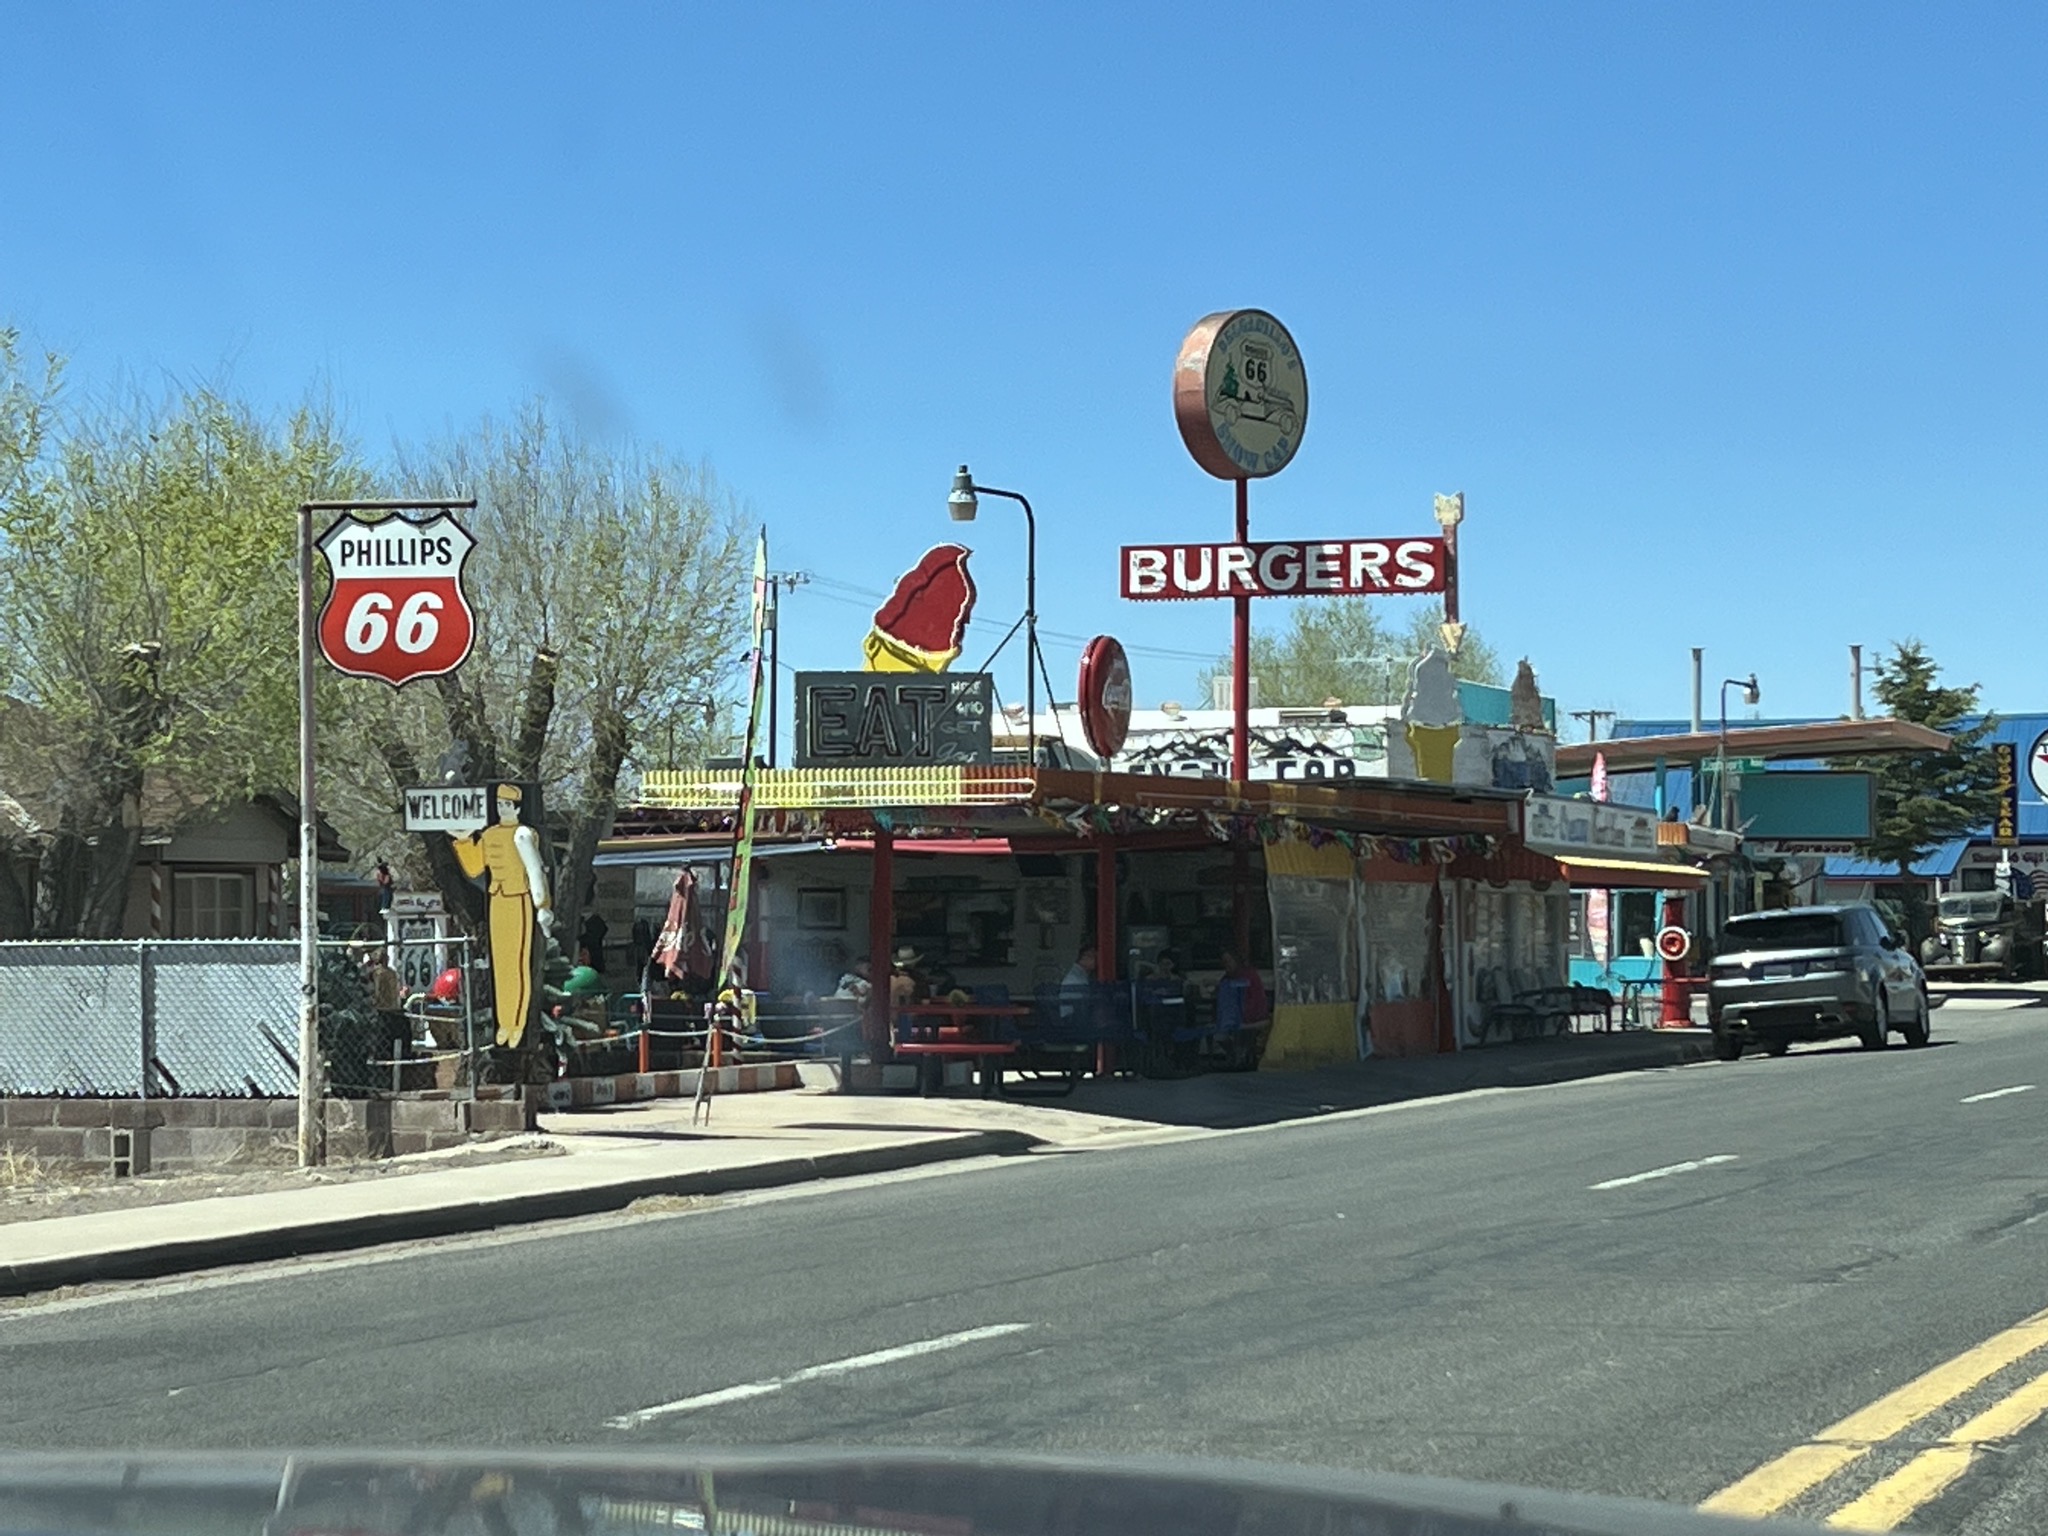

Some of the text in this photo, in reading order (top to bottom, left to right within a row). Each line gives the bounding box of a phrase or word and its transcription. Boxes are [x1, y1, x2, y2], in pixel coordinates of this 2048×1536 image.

[1245, 358, 1267, 382] 66
[340, 536, 452, 567] PHILLIPS
[1129, 541, 1435, 594] BURGERS
[344, 591, 444, 654] 66
[806, 683, 946, 759] EAT
[940, 720, 981, 734] GET
[407, 793, 485, 820] WELCOME
[405, 949, 431, 987] 66
